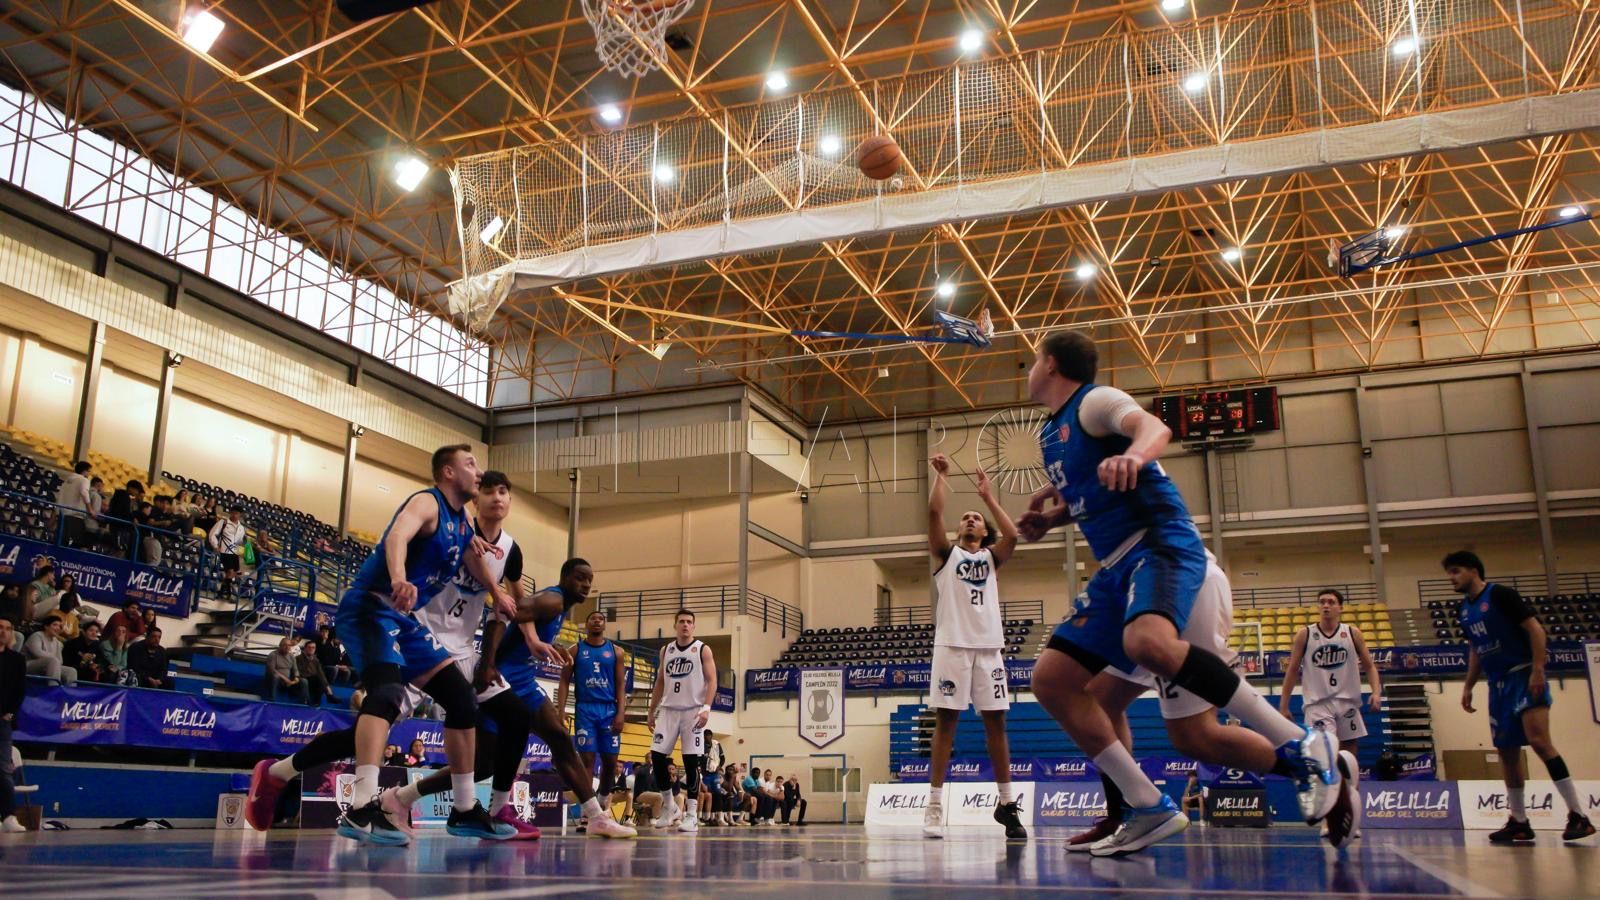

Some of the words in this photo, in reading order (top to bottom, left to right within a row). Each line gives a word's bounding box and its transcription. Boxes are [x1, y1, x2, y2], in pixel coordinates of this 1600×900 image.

[127, 570, 184, 596] MELILLA
[971, 589, 984, 605] 21
[448, 598, 468, 618] 15
[1470, 620, 1487, 637] 44
[1314, 650, 1348, 665] SALUD
[1423, 658, 1466, 666] MELILLA
[1555, 653, 1584, 663] MELIL
[593, 661, 600, 673] 3
[667, 662, 693, 676] SALUD
[754, 671, 789, 683] MELILLA
[848, 668, 887, 680] MELILLA
[908, 674, 930, 683] MELIL
[1011, 671, 1033, 680] MELI
[1329, 673, 1337, 687] 6
[673, 682, 681, 693] 8
[994, 684, 1006, 699] 21
[61, 701, 122, 720] MELILLA
[163, 708, 216, 729] MELILLA
[281, 719, 323, 736] MELILLA
[1350, 720, 1357, 731] 6
[416, 731, 445, 746] MELILL
[612, 736, 619, 747] 3
[695, 737, 700, 747] 8
[901, 763, 929, 773] MELILLA
[950, 763, 980, 772] MELILLA
[1009, 763, 1032, 772] ELILLA
[1055, 762, 1086, 772] MELILLA
[1165, 761, 1198, 771] MELILLA
[879, 794, 928, 809] MELILL
[963, 792, 1024, 808] MELIA
[1217, 796, 1259, 809] MELILLA
[1366, 790, 1450, 810] MELILLA
[1477, 793, 1553, 810] MELA
